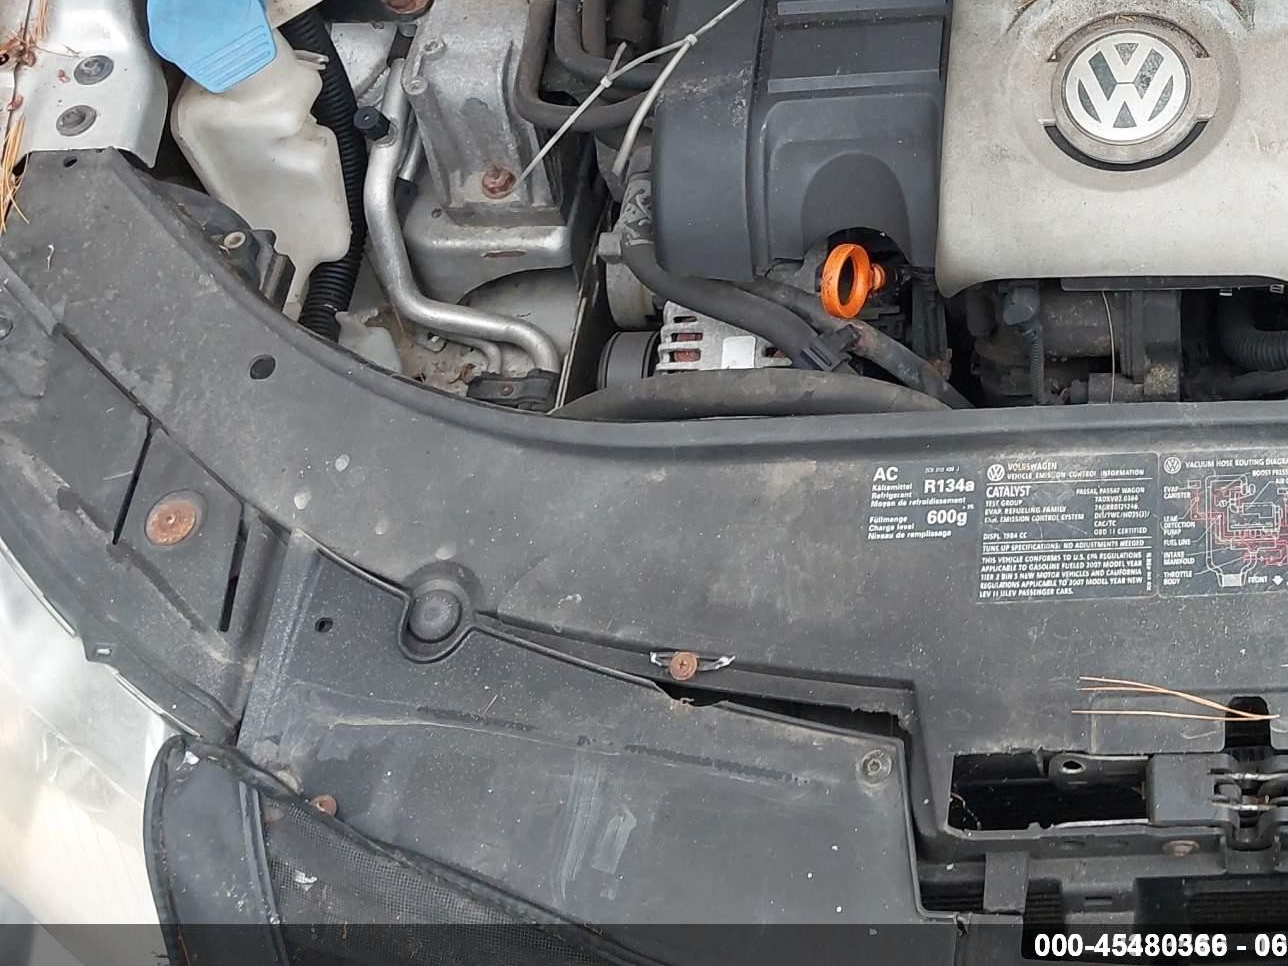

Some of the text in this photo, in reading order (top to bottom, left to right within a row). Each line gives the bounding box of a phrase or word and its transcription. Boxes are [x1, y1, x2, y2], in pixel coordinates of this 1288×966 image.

[1007, 462, 1057, 471] VOLKSWAGEN
[1235, 459, 1264, 467] ROUTING
[873, 466, 899, 482] AC
[1101, 469, 1144, 477] INFORMATION
[924, 478, 975, 493] R134a
[986, 486, 1032, 498] CATALYST
[870, 500, 895, 508] Moyen
[909, 497, 966, 506] refroidissement
[927, 509, 967, 526] 600g
[868, 524, 895, 532] Charge
[907, 530, 952, 538] remplissage
[1075, 540, 1118, 548] ADJUSTMENTS
[1036, 571, 1060, 579] MOTOR
[1062, 570, 1089, 578] VEHICLES
[1106, 568, 1142, 576] CALIFORNIA
[980, 581, 1020, 589] REGULATIONS
[1021, 580, 1057, 588] APPLICABLE
[1086, 577, 1108, 585] MODEL
[1163, 577, 1180, 585] BODY
[979, 590, 991, 598] LEV
[1000, 589, 1016, 597] ULEV
[1018, 588, 1054, 596] PASSENGER
